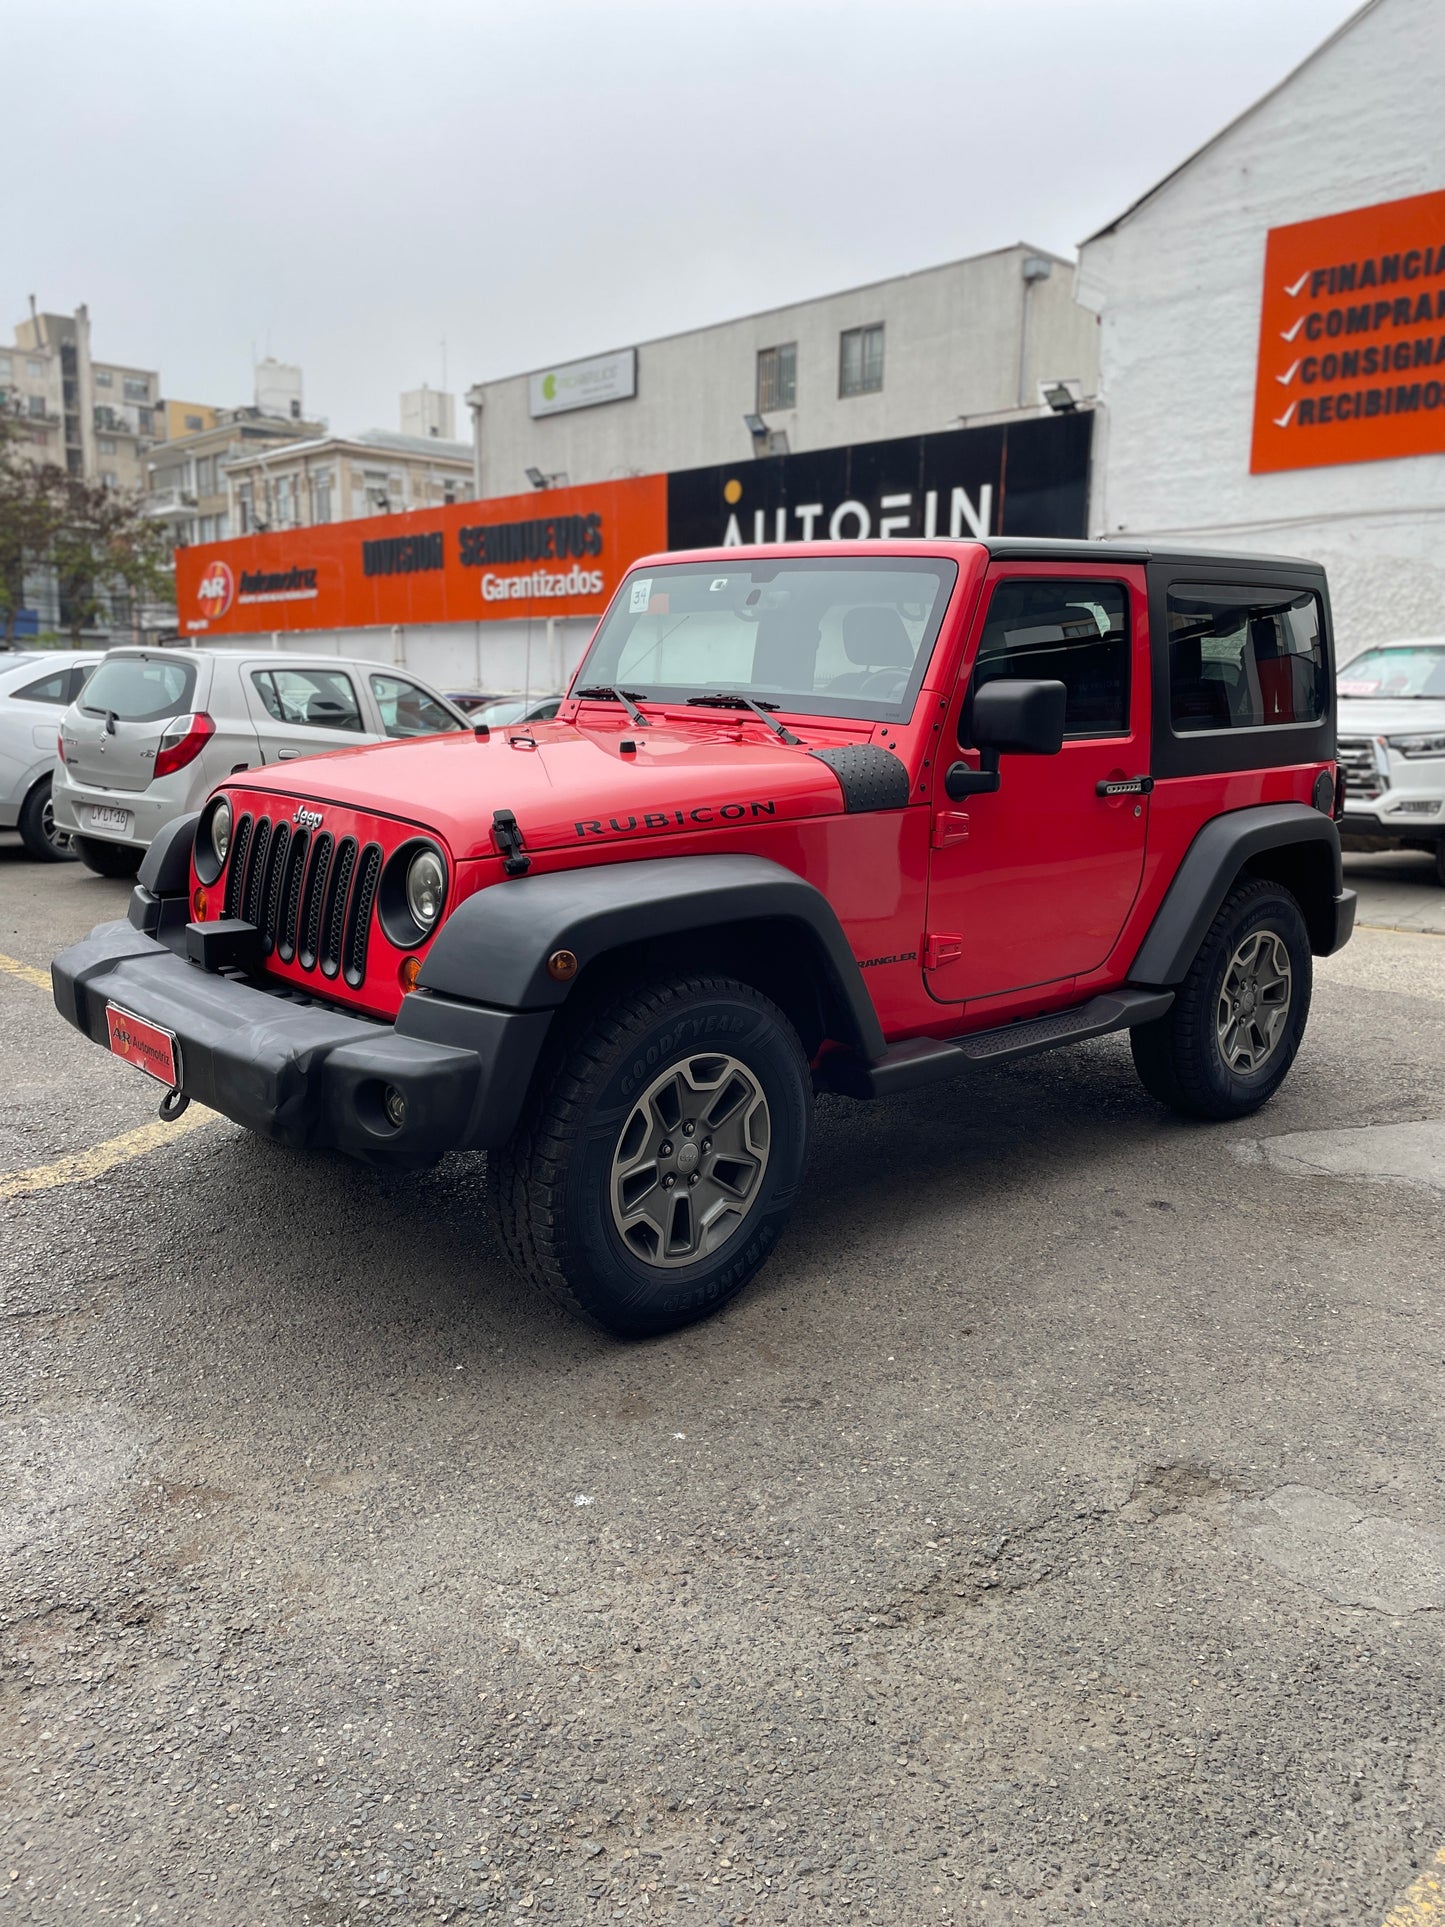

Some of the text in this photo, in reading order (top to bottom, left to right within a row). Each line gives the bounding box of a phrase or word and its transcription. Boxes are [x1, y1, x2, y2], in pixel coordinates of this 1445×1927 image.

[723, 484, 993, 548] AUTOFIN
[362, 513, 602, 577] DIVISION SEMINUEVOS
[481, 565, 603, 602] Garantizados
[292, 804, 323, 831] Jeep
[574, 800, 776, 837] RUBICON
[132, 1036, 170, 1066] Automotriz
